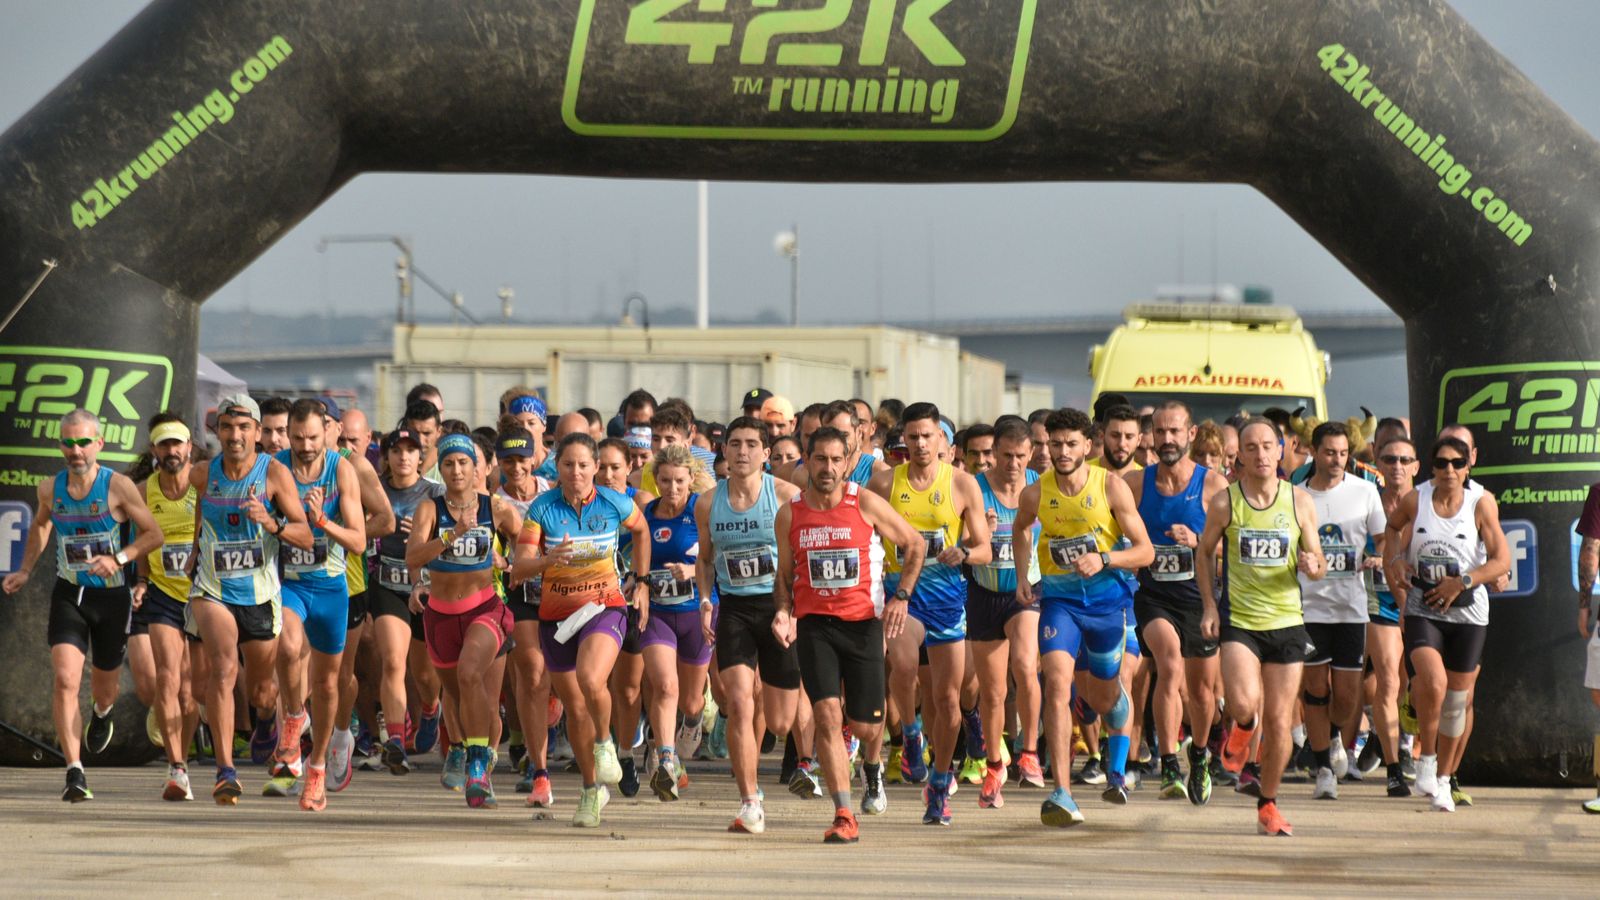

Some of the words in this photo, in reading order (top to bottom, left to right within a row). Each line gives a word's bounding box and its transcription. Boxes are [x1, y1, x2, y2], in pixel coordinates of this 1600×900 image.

[768, 67, 959, 123] running
[70, 35, 293, 230] 42krunning.com
[1316, 43, 1533, 246] 42krunning.com
[715, 518, 759, 533] nerja
[453, 537, 477, 557] 56
[800, 533, 830, 542] GUARDIA
[832, 532, 852, 540] CIVIL
[291, 547, 315, 565] 36
[1058, 543, 1088, 565] 157
[1248, 538, 1281, 559] 128
[222, 550, 255, 571] 124
[738, 557, 760, 578] 67
[822, 559, 847, 580] 84
[1157, 554, 1180, 573] 23
[1427, 564, 1447, 581] 10
[550, 581, 608, 596] Algeciras
[659, 578, 678, 597] 21
